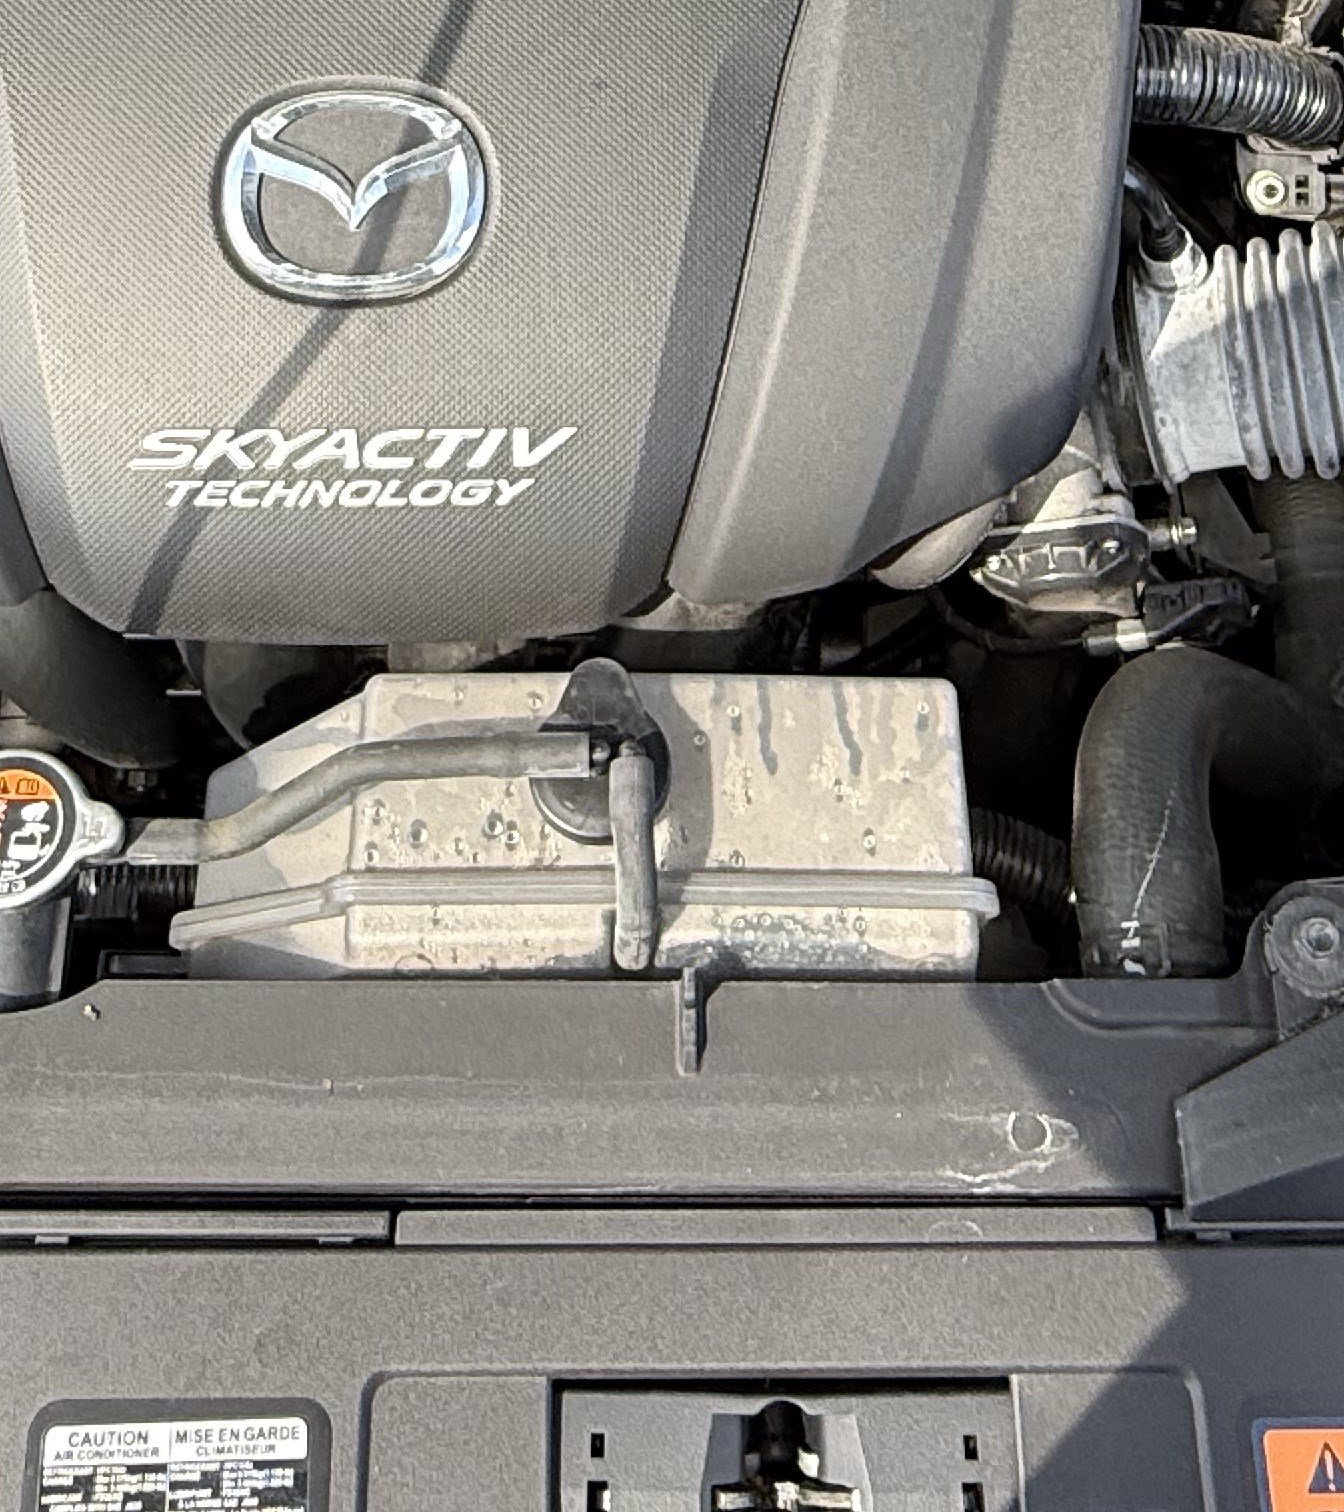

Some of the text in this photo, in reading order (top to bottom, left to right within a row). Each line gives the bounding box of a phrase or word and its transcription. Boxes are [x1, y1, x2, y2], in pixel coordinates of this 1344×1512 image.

[127, 426, 578, 471] SKYACTIV
[164, 478, 538, 508] TECHNOLOGY
[68, 1429, 149, 1448] CAUTION
[175, 1425, 300, 1444] MISE EN GARDE
[54, 1447, 160, 1462] AIR CONDITIONER
